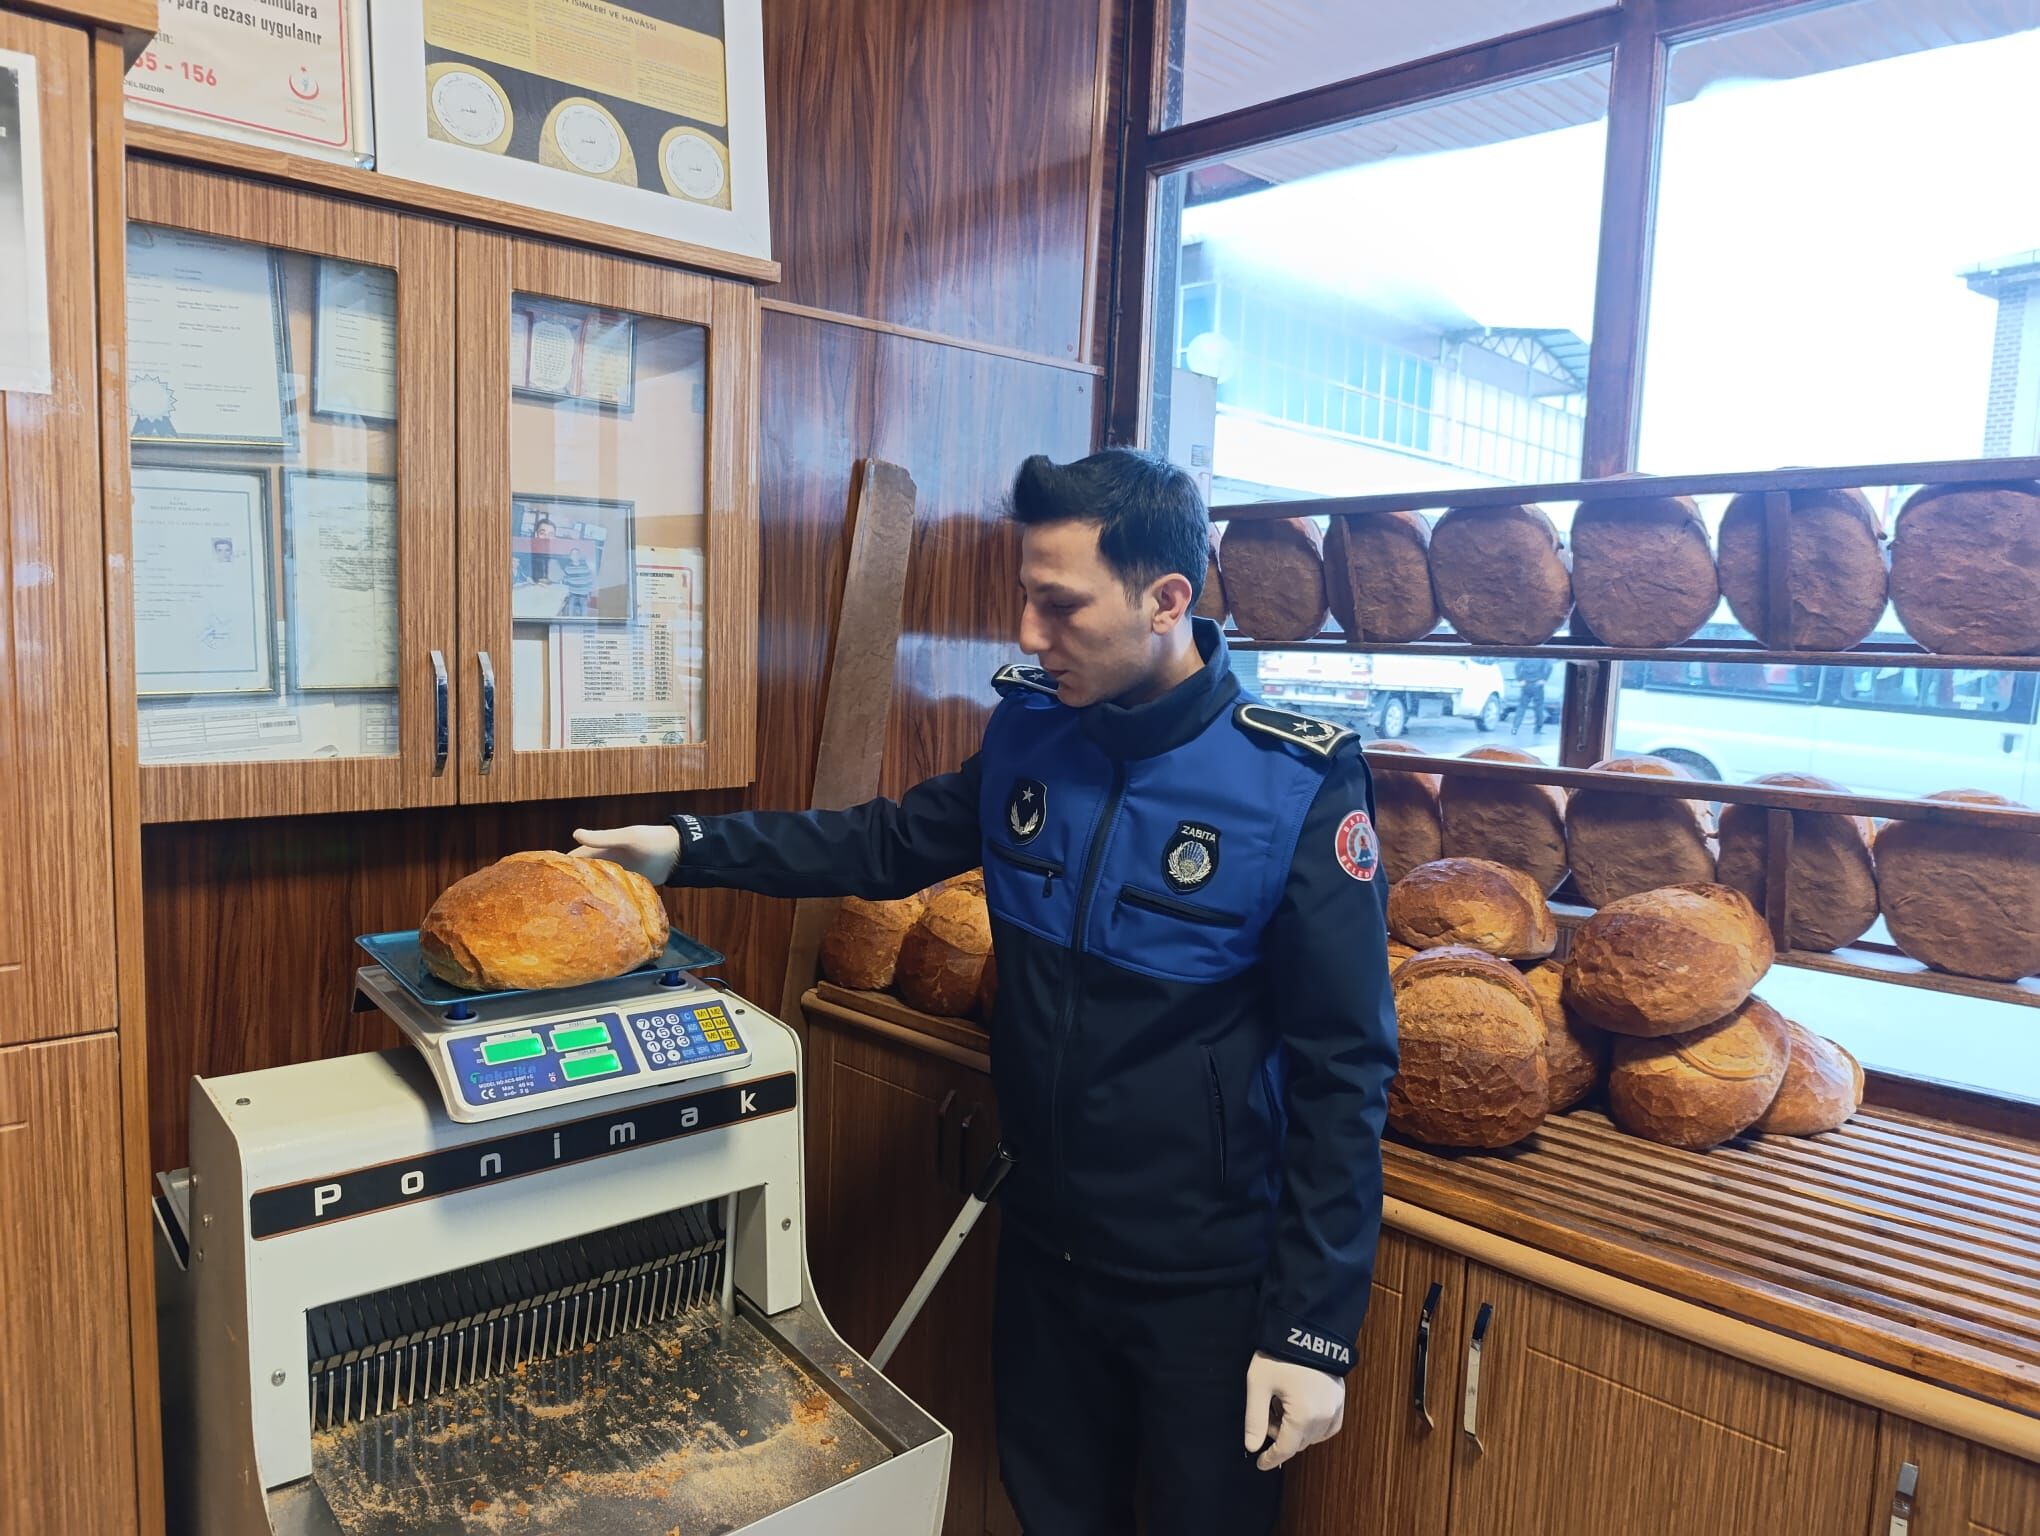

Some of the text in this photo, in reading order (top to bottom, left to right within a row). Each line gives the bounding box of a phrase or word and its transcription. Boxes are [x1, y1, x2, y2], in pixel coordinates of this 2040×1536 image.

[213, 4, 256, 27] cezası
[261, 18, 322, 45] uygulanır
[181, 62, 217, 86] 156
[1181, 825, 1216, 843] ZABITA
[697, 1010, 708, 1018] M1
[1287, 1327, 1350, 1364] ZABITA
